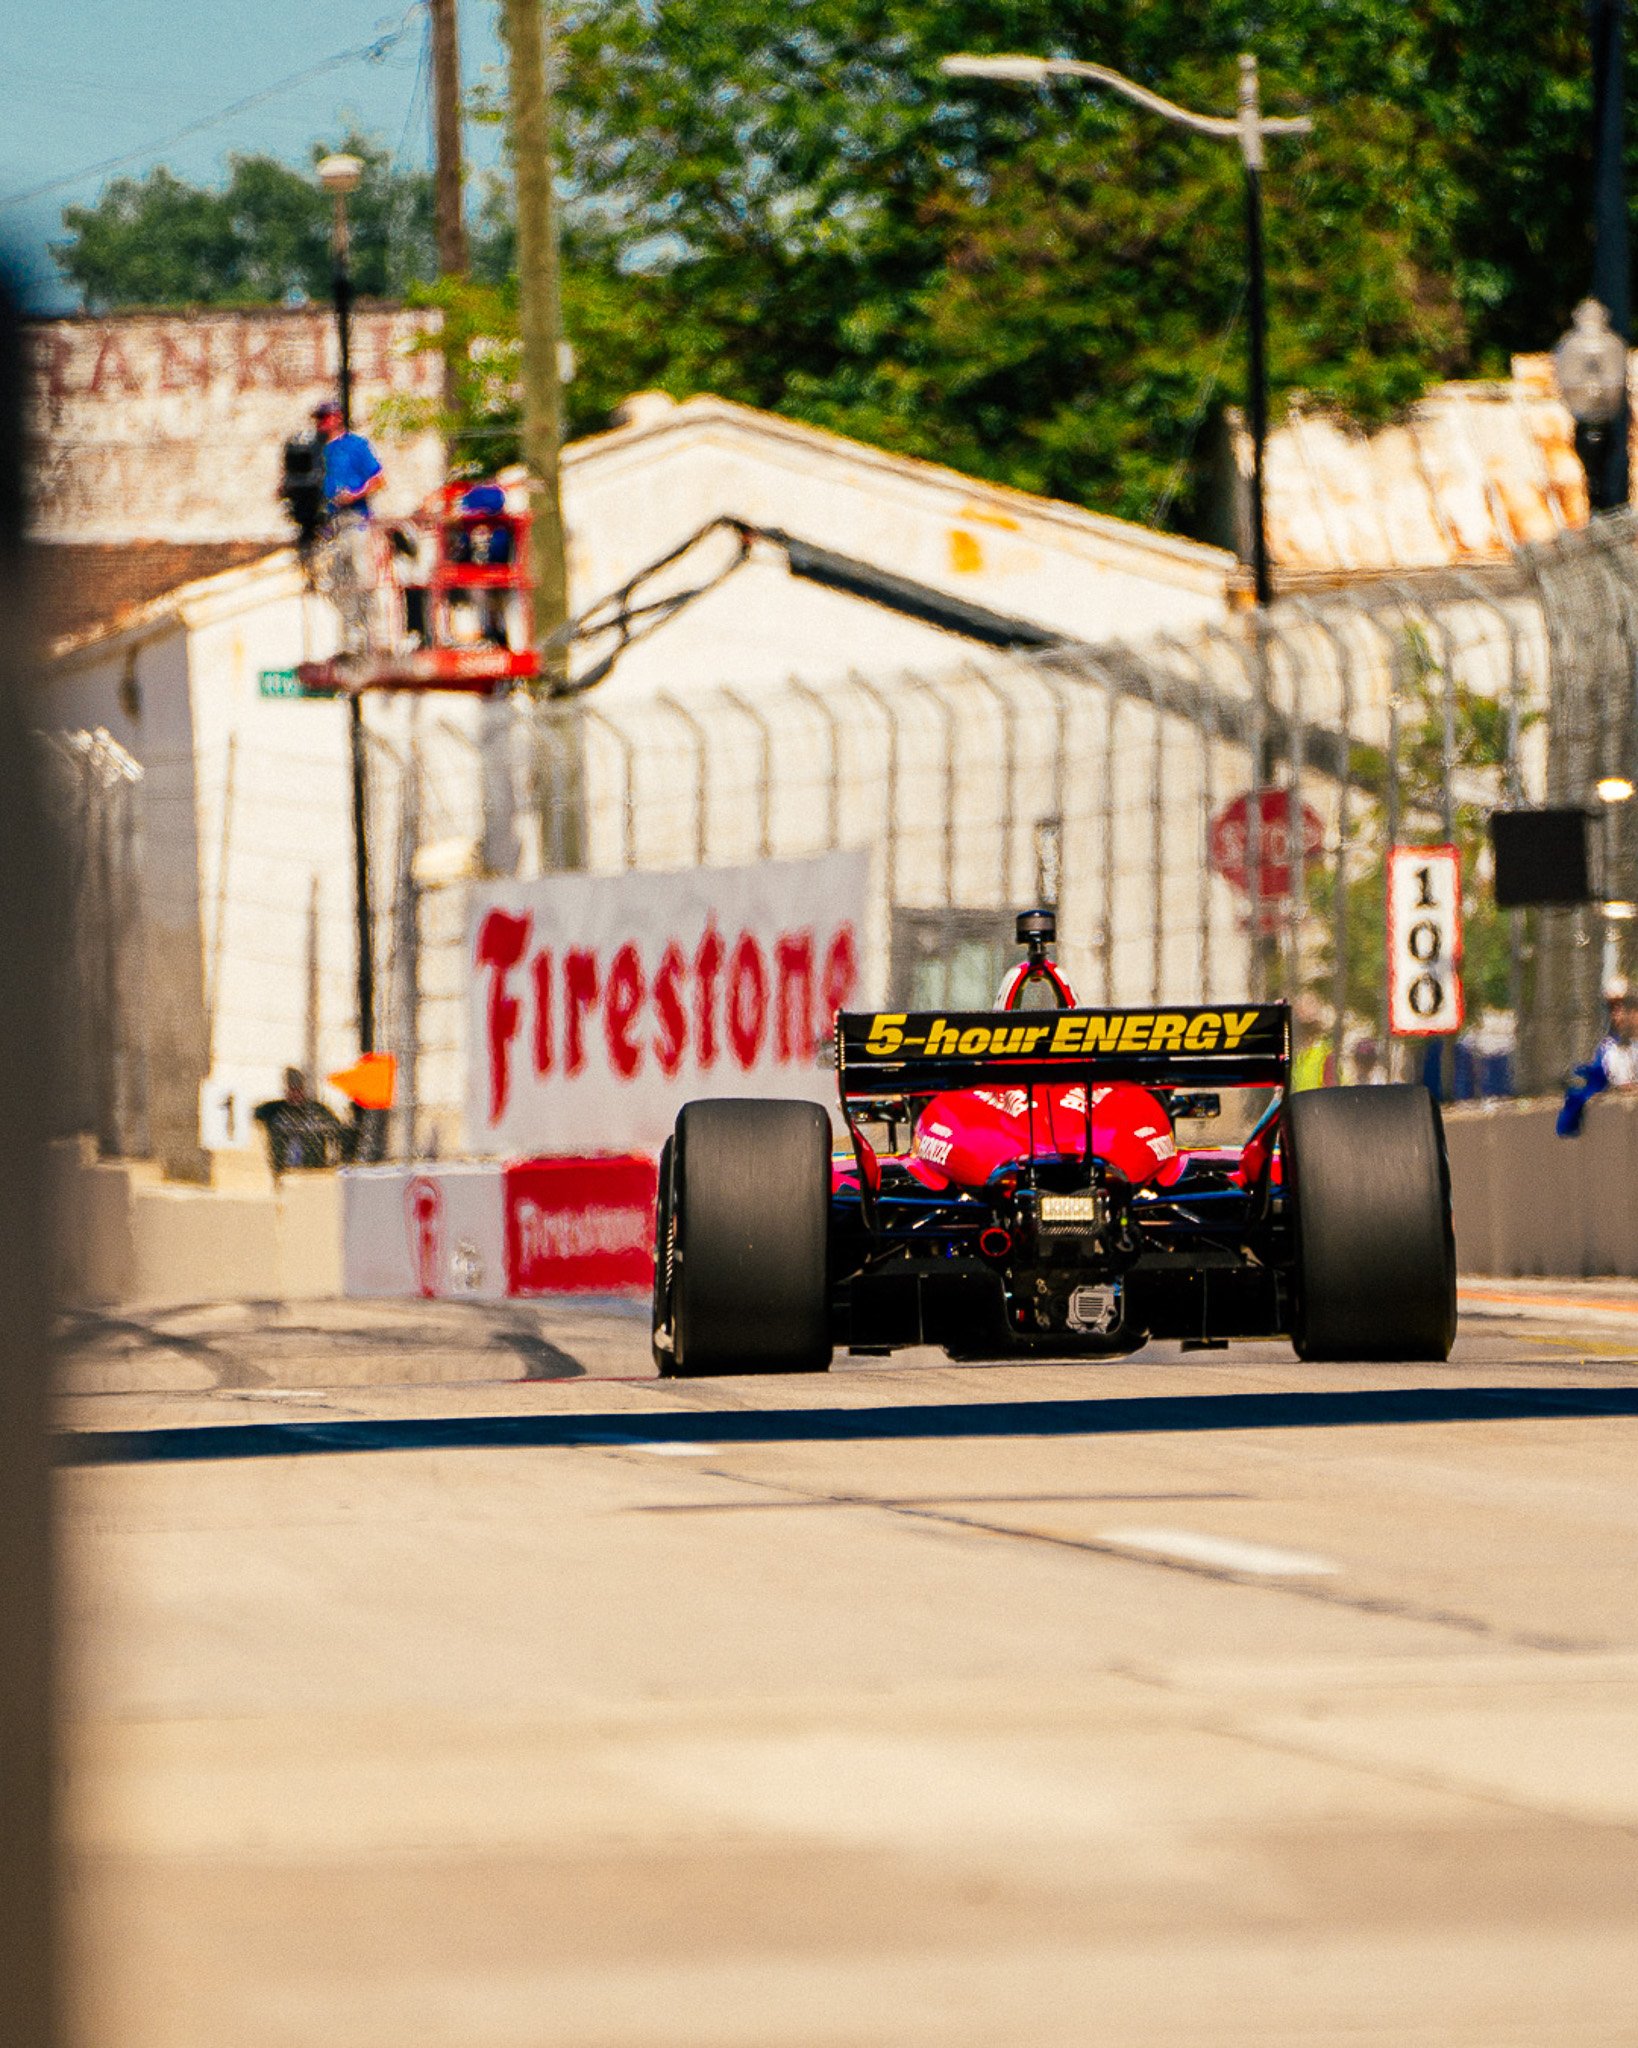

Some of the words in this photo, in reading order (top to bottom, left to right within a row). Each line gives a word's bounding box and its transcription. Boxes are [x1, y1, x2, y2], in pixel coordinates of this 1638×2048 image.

[1219, 819, 1323, 869] SOP
[1406, 865, 1444, 1018] 100
[476, 907, 857, 1128] Firestone
[865, 1013, 1050, 1056] 5-hour
[1049, 1011, 1260, 1053] ENERGY
